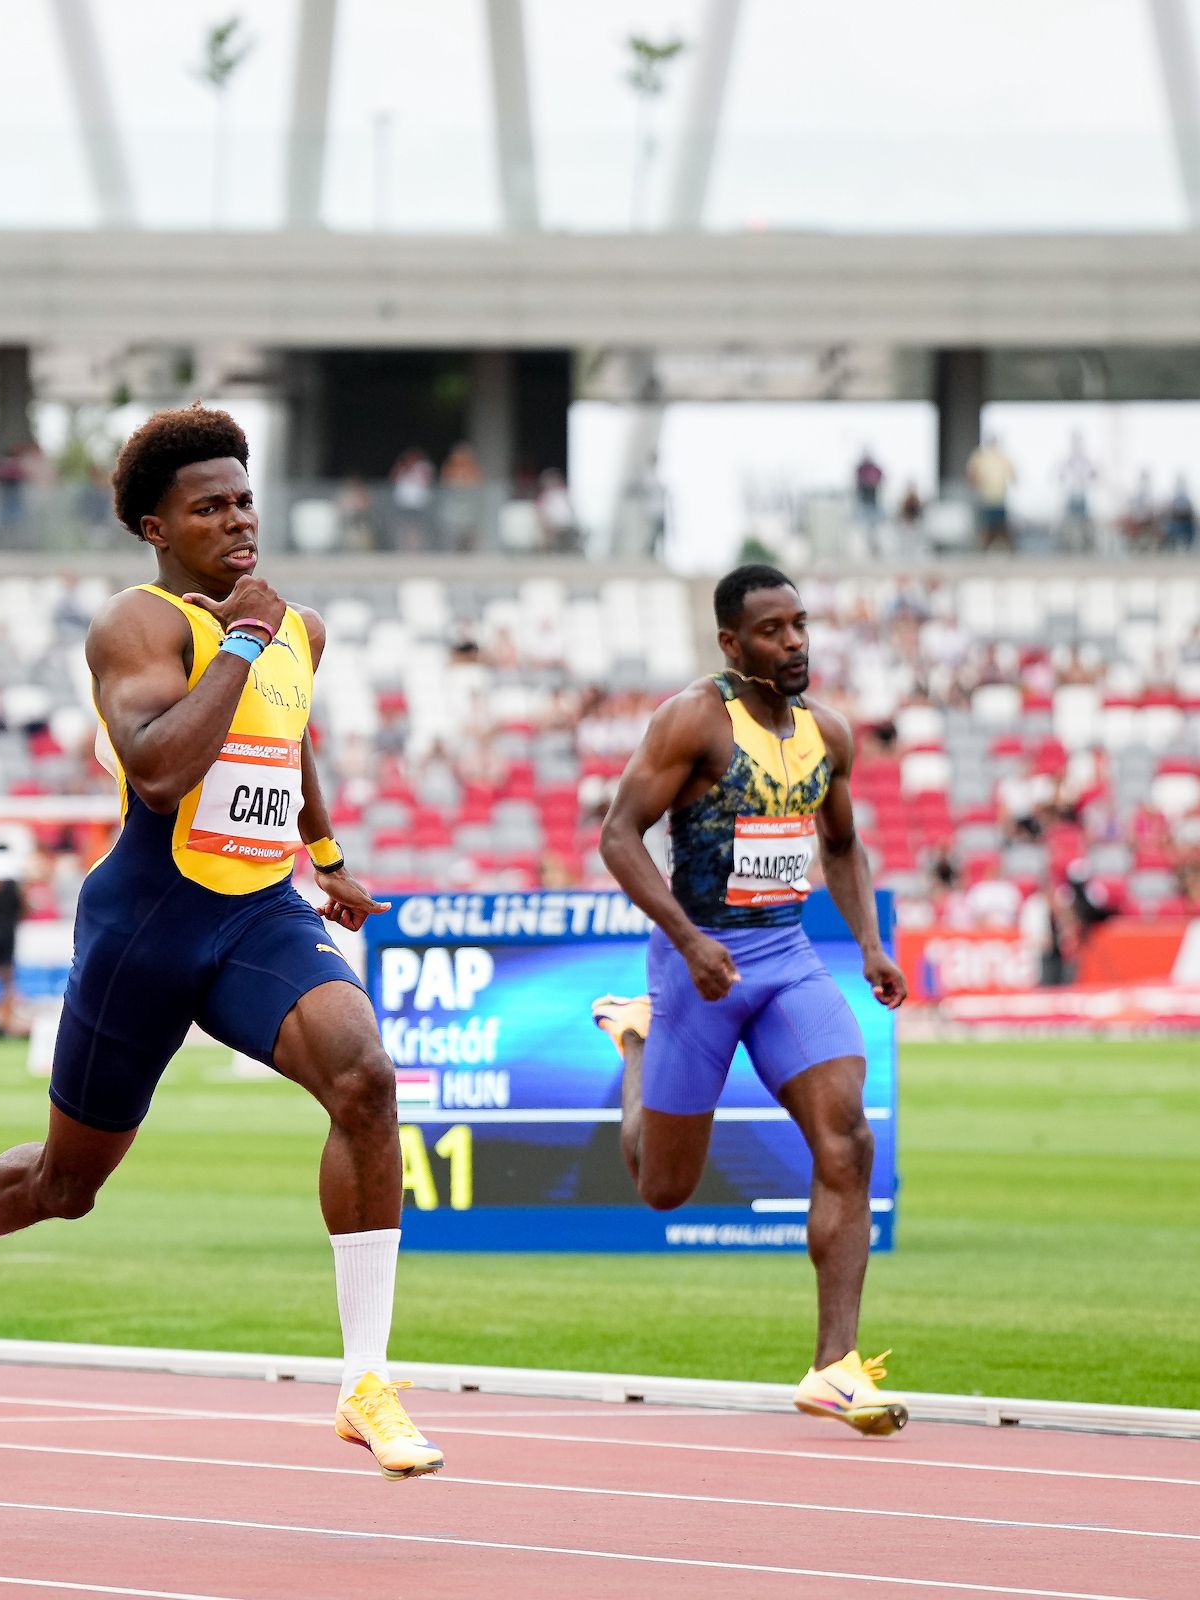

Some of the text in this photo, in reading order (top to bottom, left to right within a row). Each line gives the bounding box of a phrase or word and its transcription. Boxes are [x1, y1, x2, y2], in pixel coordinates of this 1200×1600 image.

[229, 784, 290, 827] CARD
[238, 845, 284, 858] PROHUMAN
[398, 895, 655, 937] ONLINETIM
[381, 946, 494, 1011] PAP
[381, 1015, 500, 1065] Kristóf
[443, 1070, 511, 1108] HUN
